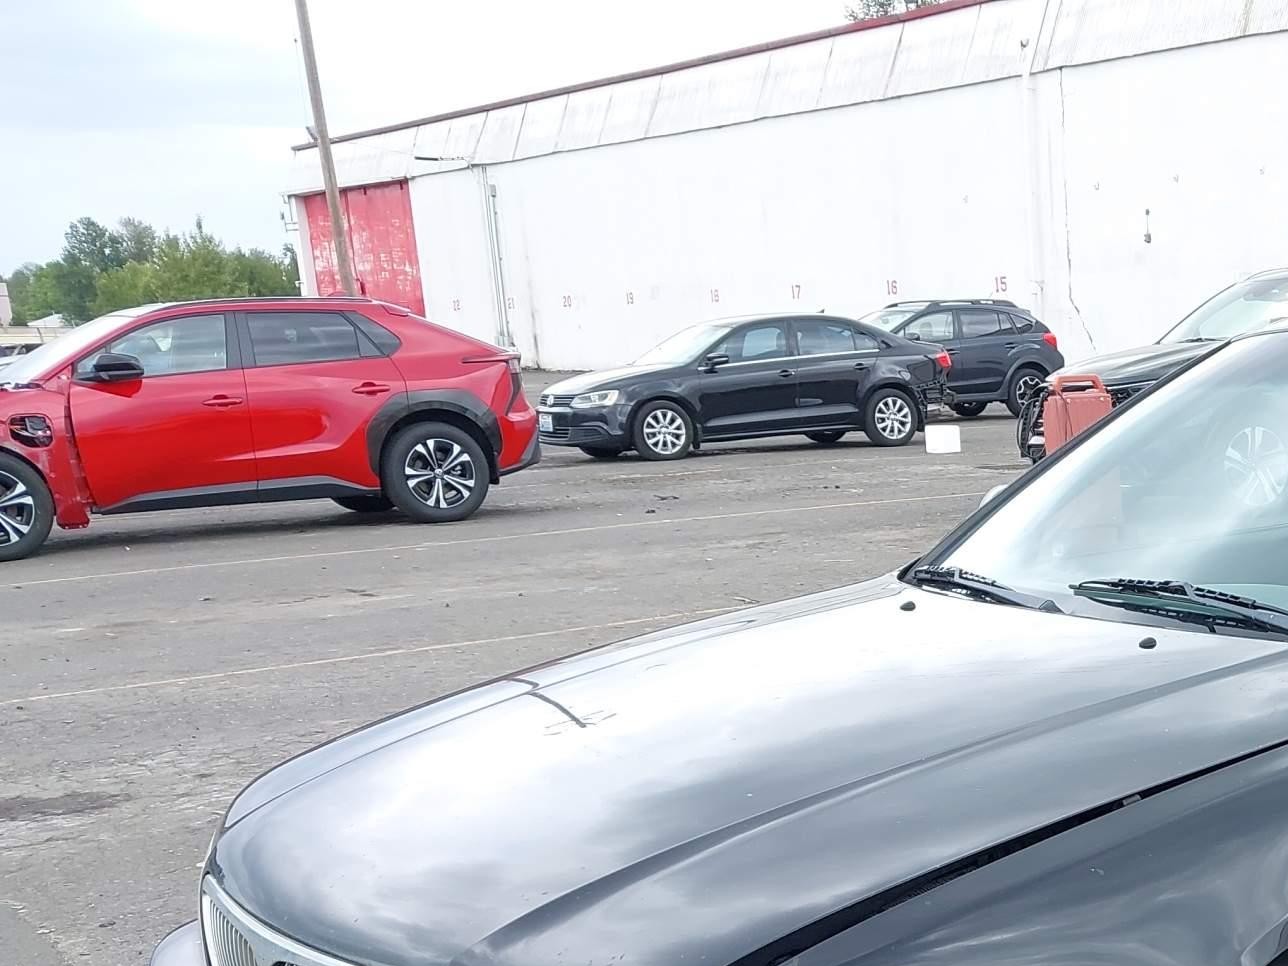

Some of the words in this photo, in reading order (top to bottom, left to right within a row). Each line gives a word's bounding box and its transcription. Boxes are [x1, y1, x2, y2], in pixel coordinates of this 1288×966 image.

[791, 284, 800, 300] 17
[886, 280, 898, 295] 16
[994, 276, 1007, 293] 15
[563, 295, 572, 308] 20
[626, 291, 634, 304] 19
[710, 288, 720, 303] 18
